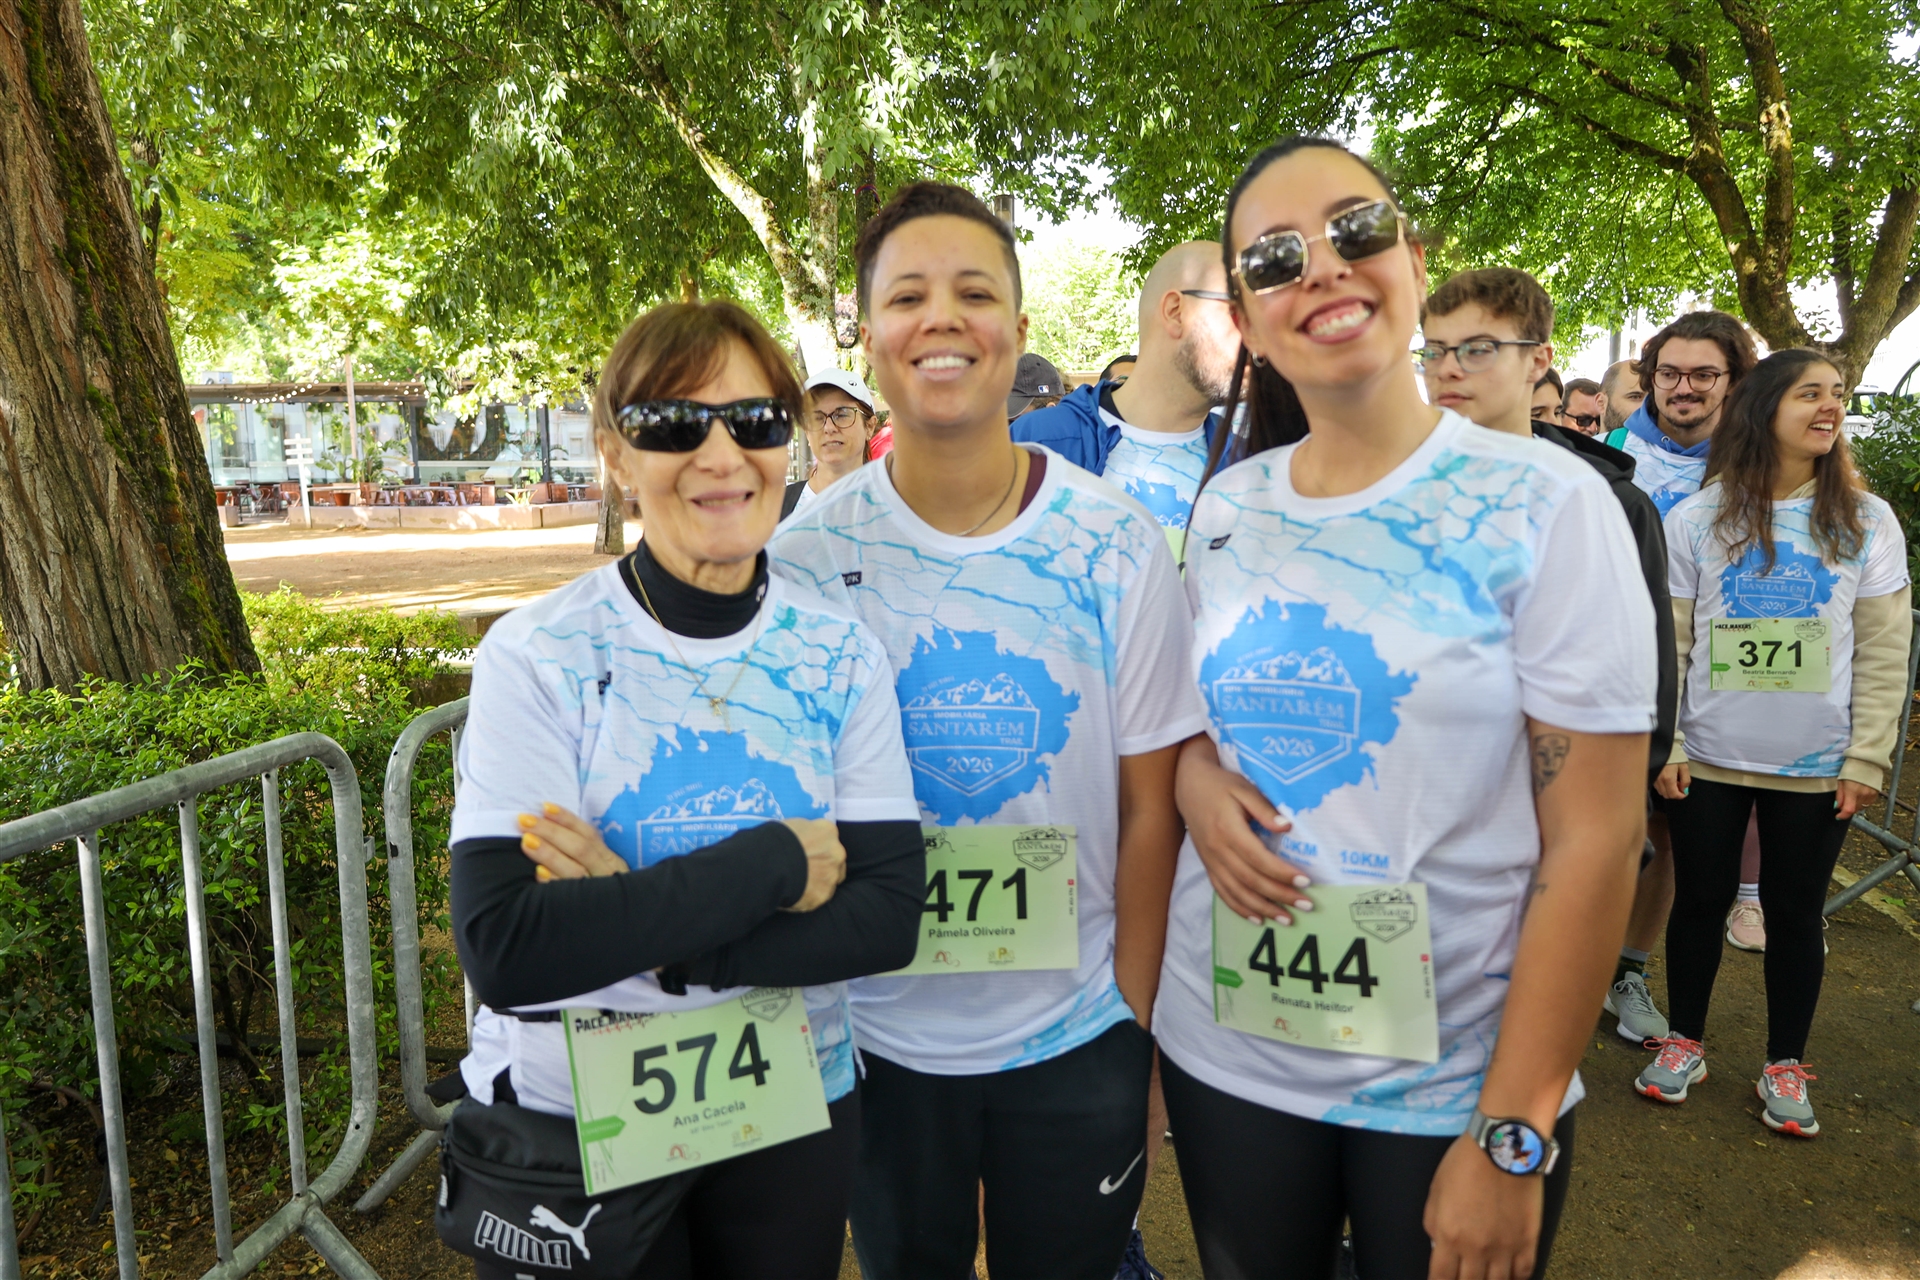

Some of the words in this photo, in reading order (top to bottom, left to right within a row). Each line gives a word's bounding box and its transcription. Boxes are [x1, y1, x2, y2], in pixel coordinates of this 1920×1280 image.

[1760, 600, 1787, 611] 2026
[1738, 640, 1802, 668] 371
[1221, 695, 1345, 719] SANTARÉM
[908, 717, 1025, 736] SANTARÉM
[1261, 735, 1316, 758] 2026
[946, 756, 994, 773] 2026
[650, 834, 724, 854] SANT
[1340, 850, 1390, 869] 10KM
[923, 867, 1028, 923] 471
[972, 926, 1016, 937] Oliveira
[1248, 927, 1379, 998] 444
[1271, 992, 1312, 1010] Renata
[1314, 1000, 1354, 1013] Heitor
[633, 1022, 771, 1115] 574
[673, 1114, 700, 1128] Ana
[703, 1100, 746, 1120] Cacela
[474, 1210, 572, 1270] PUMA
